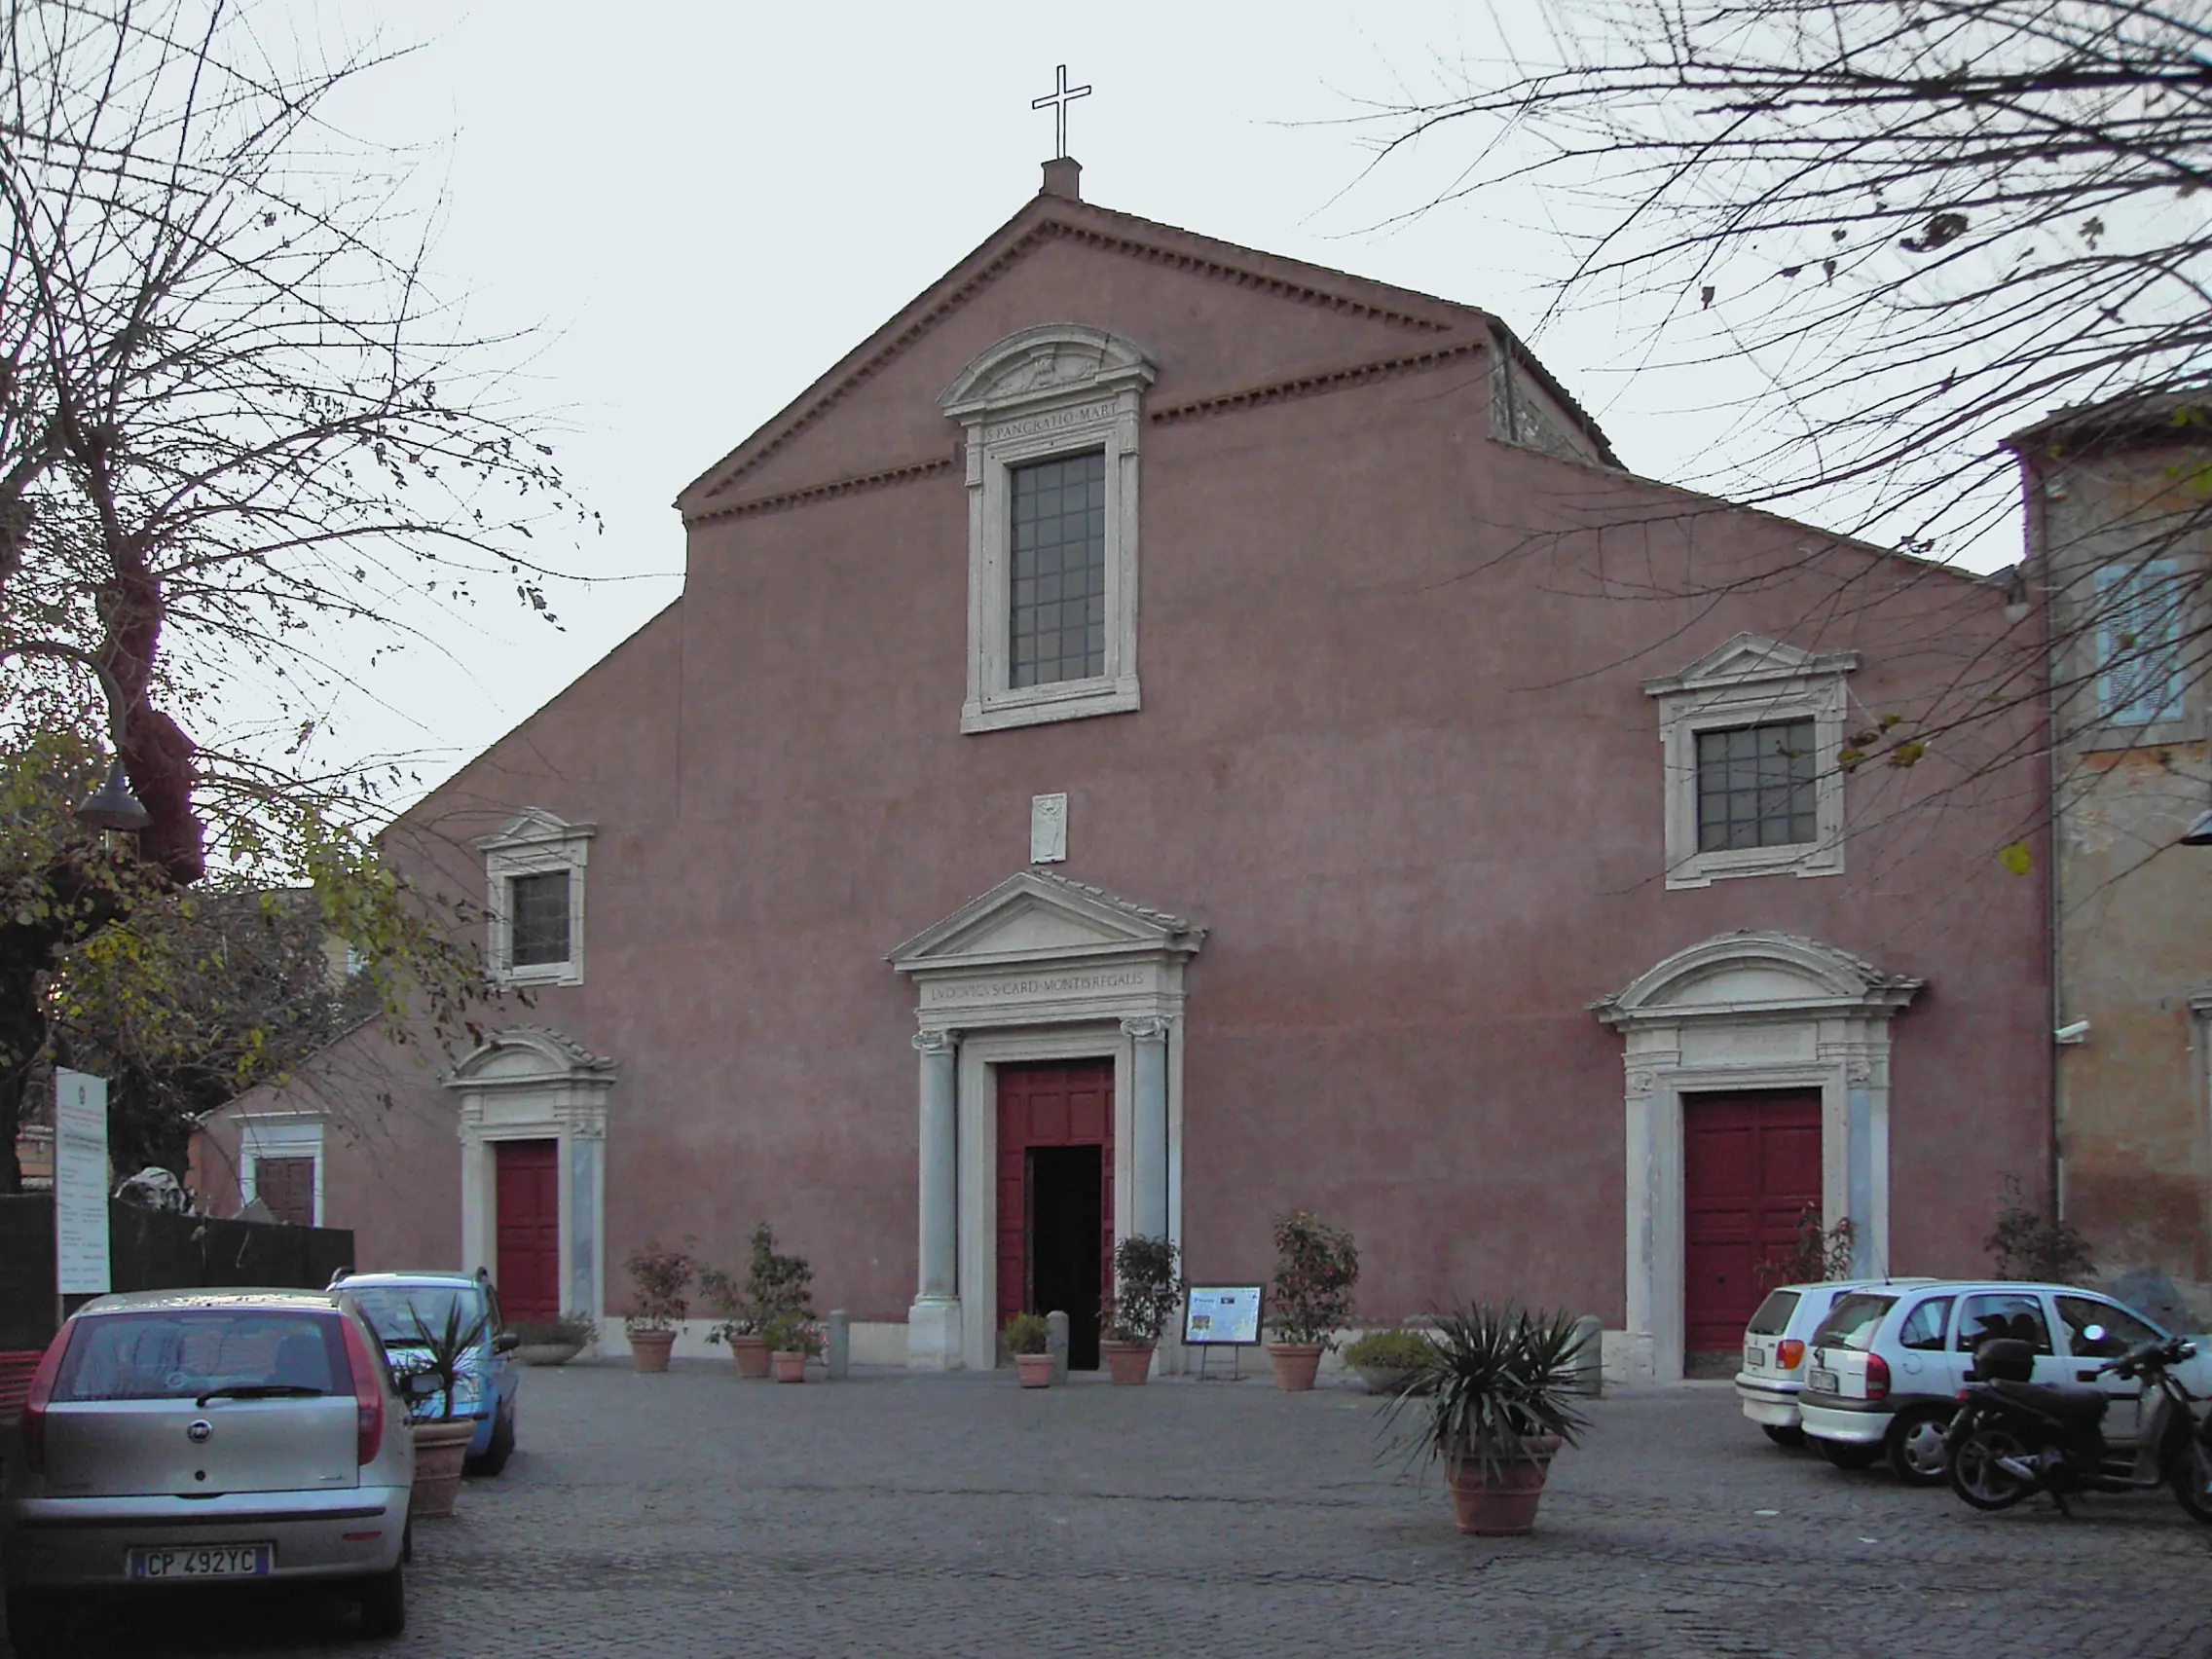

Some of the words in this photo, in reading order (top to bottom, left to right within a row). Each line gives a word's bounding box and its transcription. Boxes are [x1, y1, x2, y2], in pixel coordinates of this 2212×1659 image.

[997, 411, 1074, 439] PANCRATIO
[1002, 980, 1039, 996] CARD
[1092, 971, 1144, 987] REGALIS
[148, 1553, 174, 1575] CP
[183, 1550, 253, 1574] 492YC
